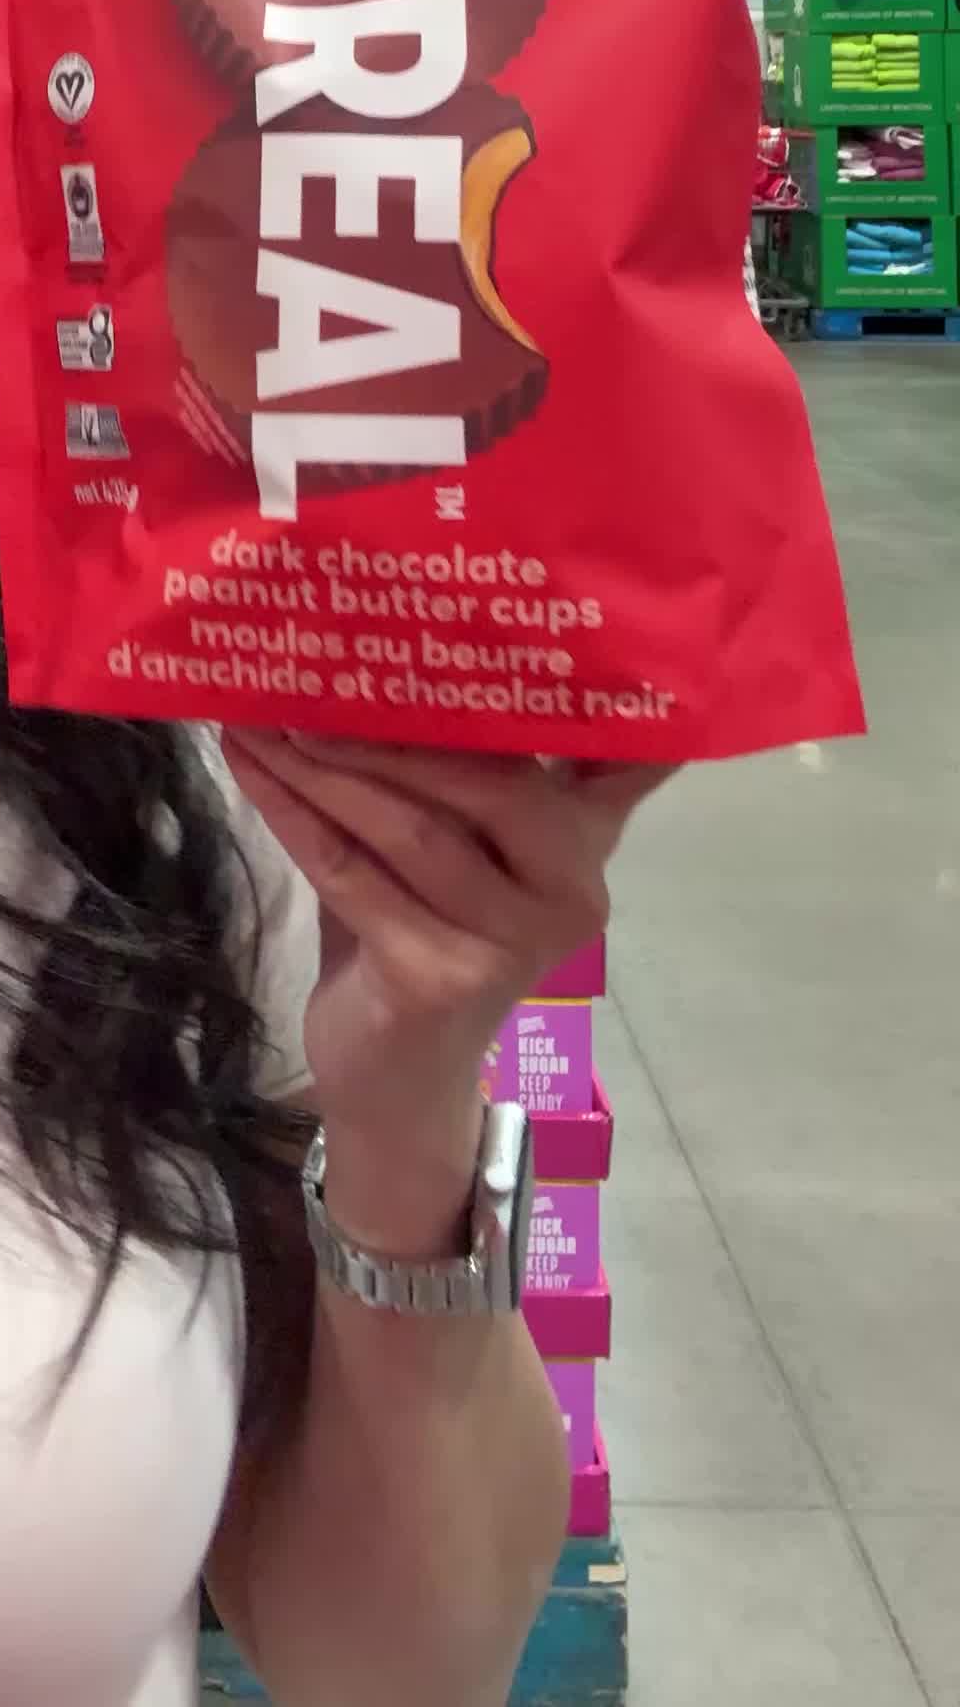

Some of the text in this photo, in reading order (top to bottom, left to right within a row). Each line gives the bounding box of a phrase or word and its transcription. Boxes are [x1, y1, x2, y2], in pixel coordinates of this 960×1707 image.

[209, 528, 547, 587] dark chocolate
[163, 567, 604, 634] peanut butter cups
[189, 617, 575, 678] moules au beurre
[106, 640, 678, 721] d'arachide et chocolat noir
[518, 1036, 555, 1054] KICK
[518, 1056, 569, 1075] SUGAR
[519, 1075, 551, 1093] KEEP
[519, 1094, 564, 1111] CANDY
